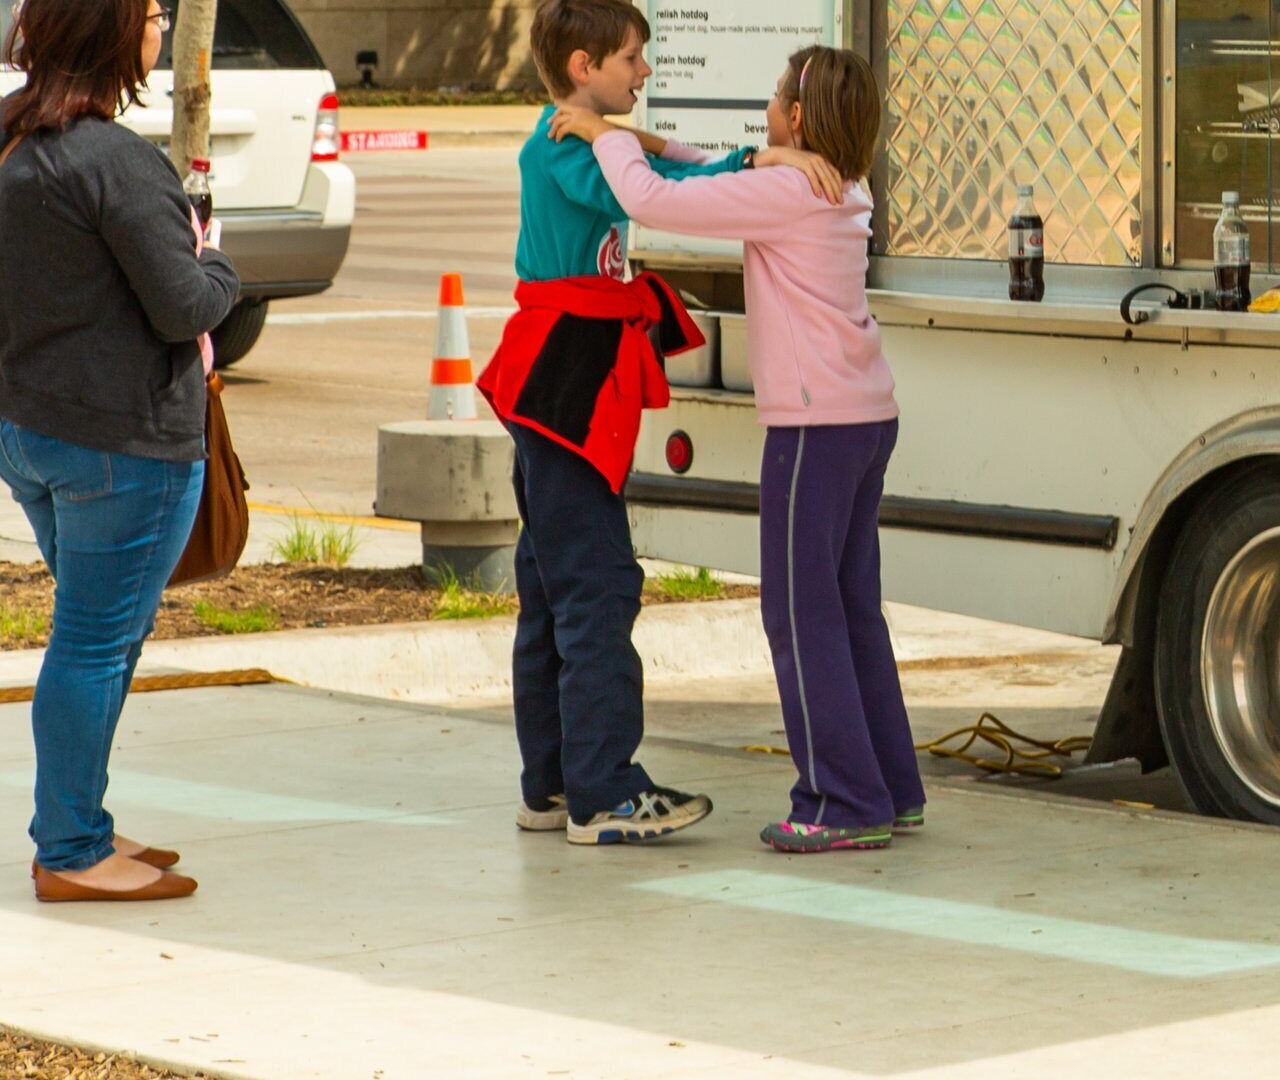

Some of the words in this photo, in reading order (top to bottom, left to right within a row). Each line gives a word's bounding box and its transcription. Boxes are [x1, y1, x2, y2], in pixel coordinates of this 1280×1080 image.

[656, 10, 678, 19] relish
[680, 10, 708, 21] hotdog
[656, 55, 675, 67] plain
[677, 56, 706, 67] hotdog
[656, 121, 677, 130] sides
[721, 141, 739, 151] fries
